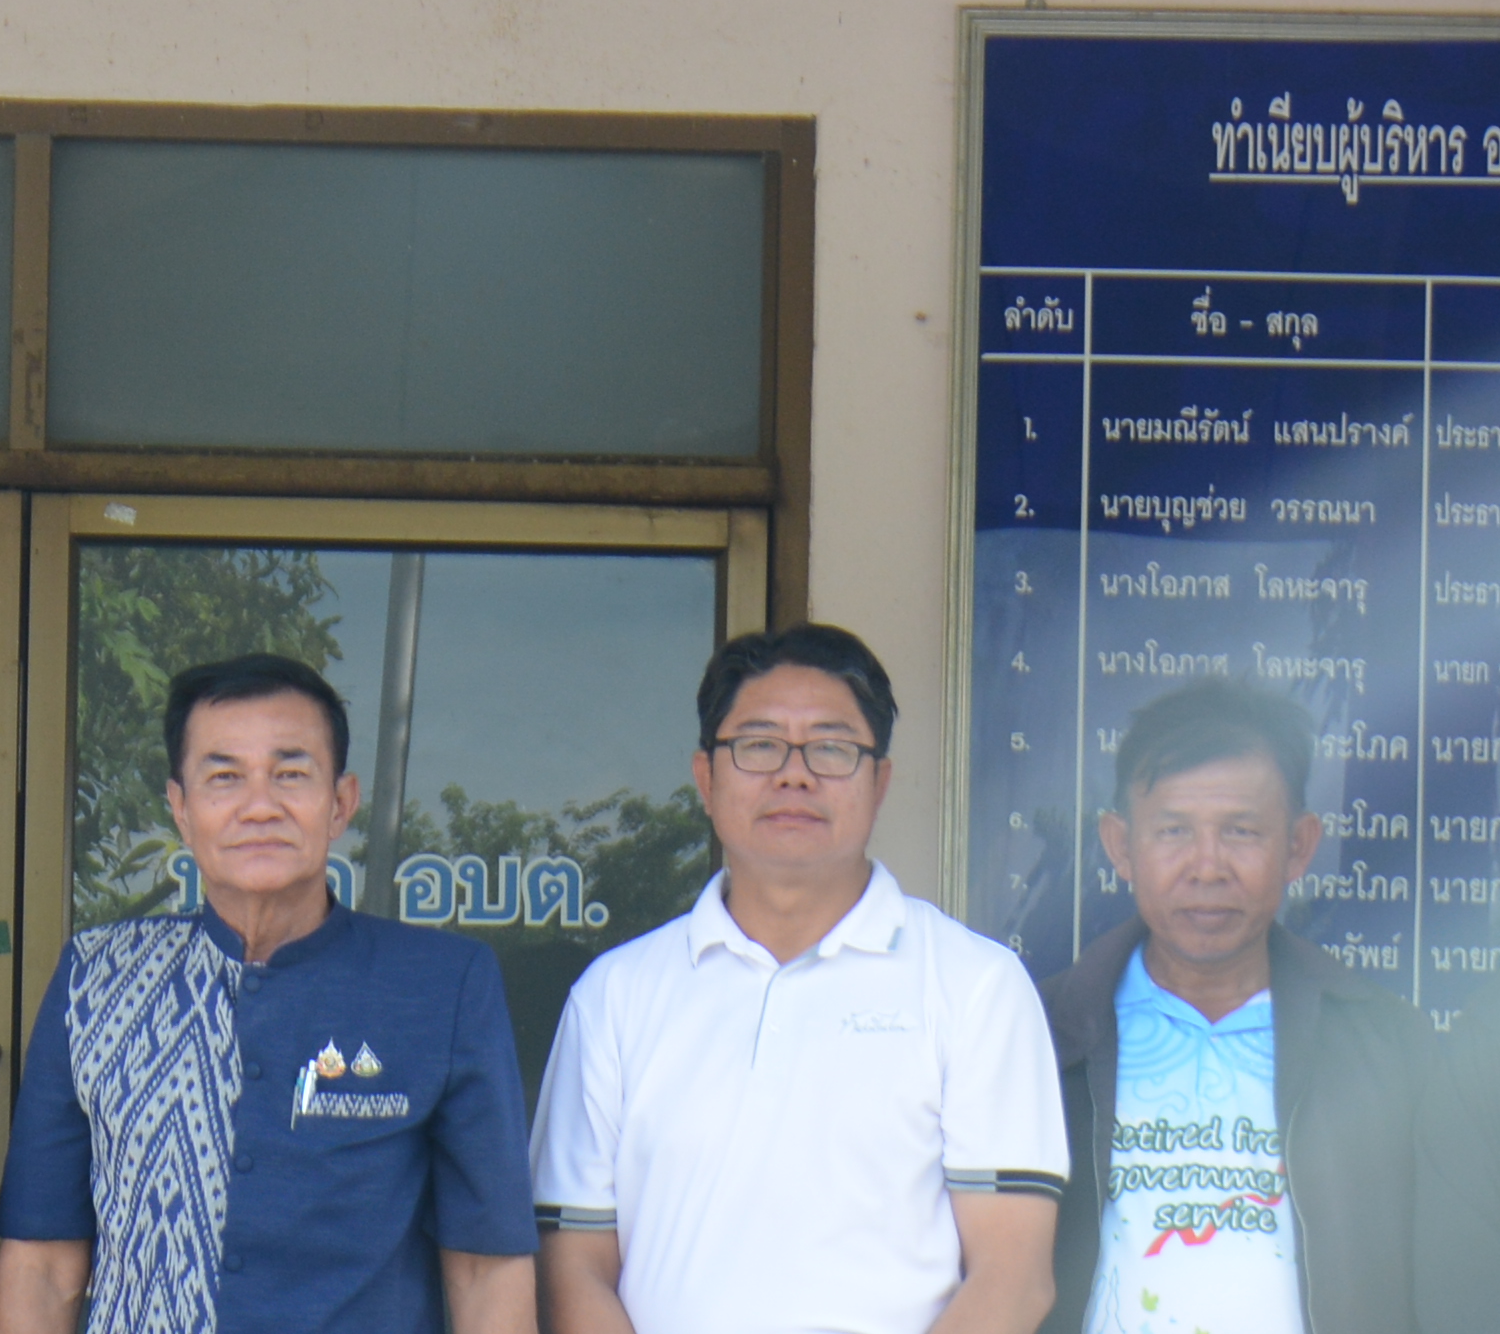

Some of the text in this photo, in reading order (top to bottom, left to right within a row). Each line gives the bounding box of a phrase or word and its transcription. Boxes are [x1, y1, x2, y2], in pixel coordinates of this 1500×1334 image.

[1210, 90, 1468, 205] ทำเนียบผู้บริหาร
[1004, 295, 1074, 331] ลำดับ
[1190, 285, 1227, 335] ชื่อ
[1266, 310, 1319, 351] สกุล
[1023, 416, 1037, 440] 1.
[1102, 404, 1412, 445] นายมณีรัตน์ แสนปรางค์
[1014, 493, 1035, 517] 2.
[1100, 483, 1376, 532] นายบุญช่วย วรรณนา
[1014, 570, 1033, 594] 3.
[1100, 560, 1369, 615] นางโอภาส โลหะจารุ
[1010, 650, 1030, 673] 4.
[1097, 638, 1367, 695] นางโอภาส โลหะจารุ
[1433, 660, 1489, 684] นายก
[1010, 731, 1030, 751] 5.
[1009, 811, 1029, 830] 6.
[395, 853, 609, 928] อบต.
[1009, 873, 1028, 890] 7.
[1154, 1198, 1278, 1232] service
